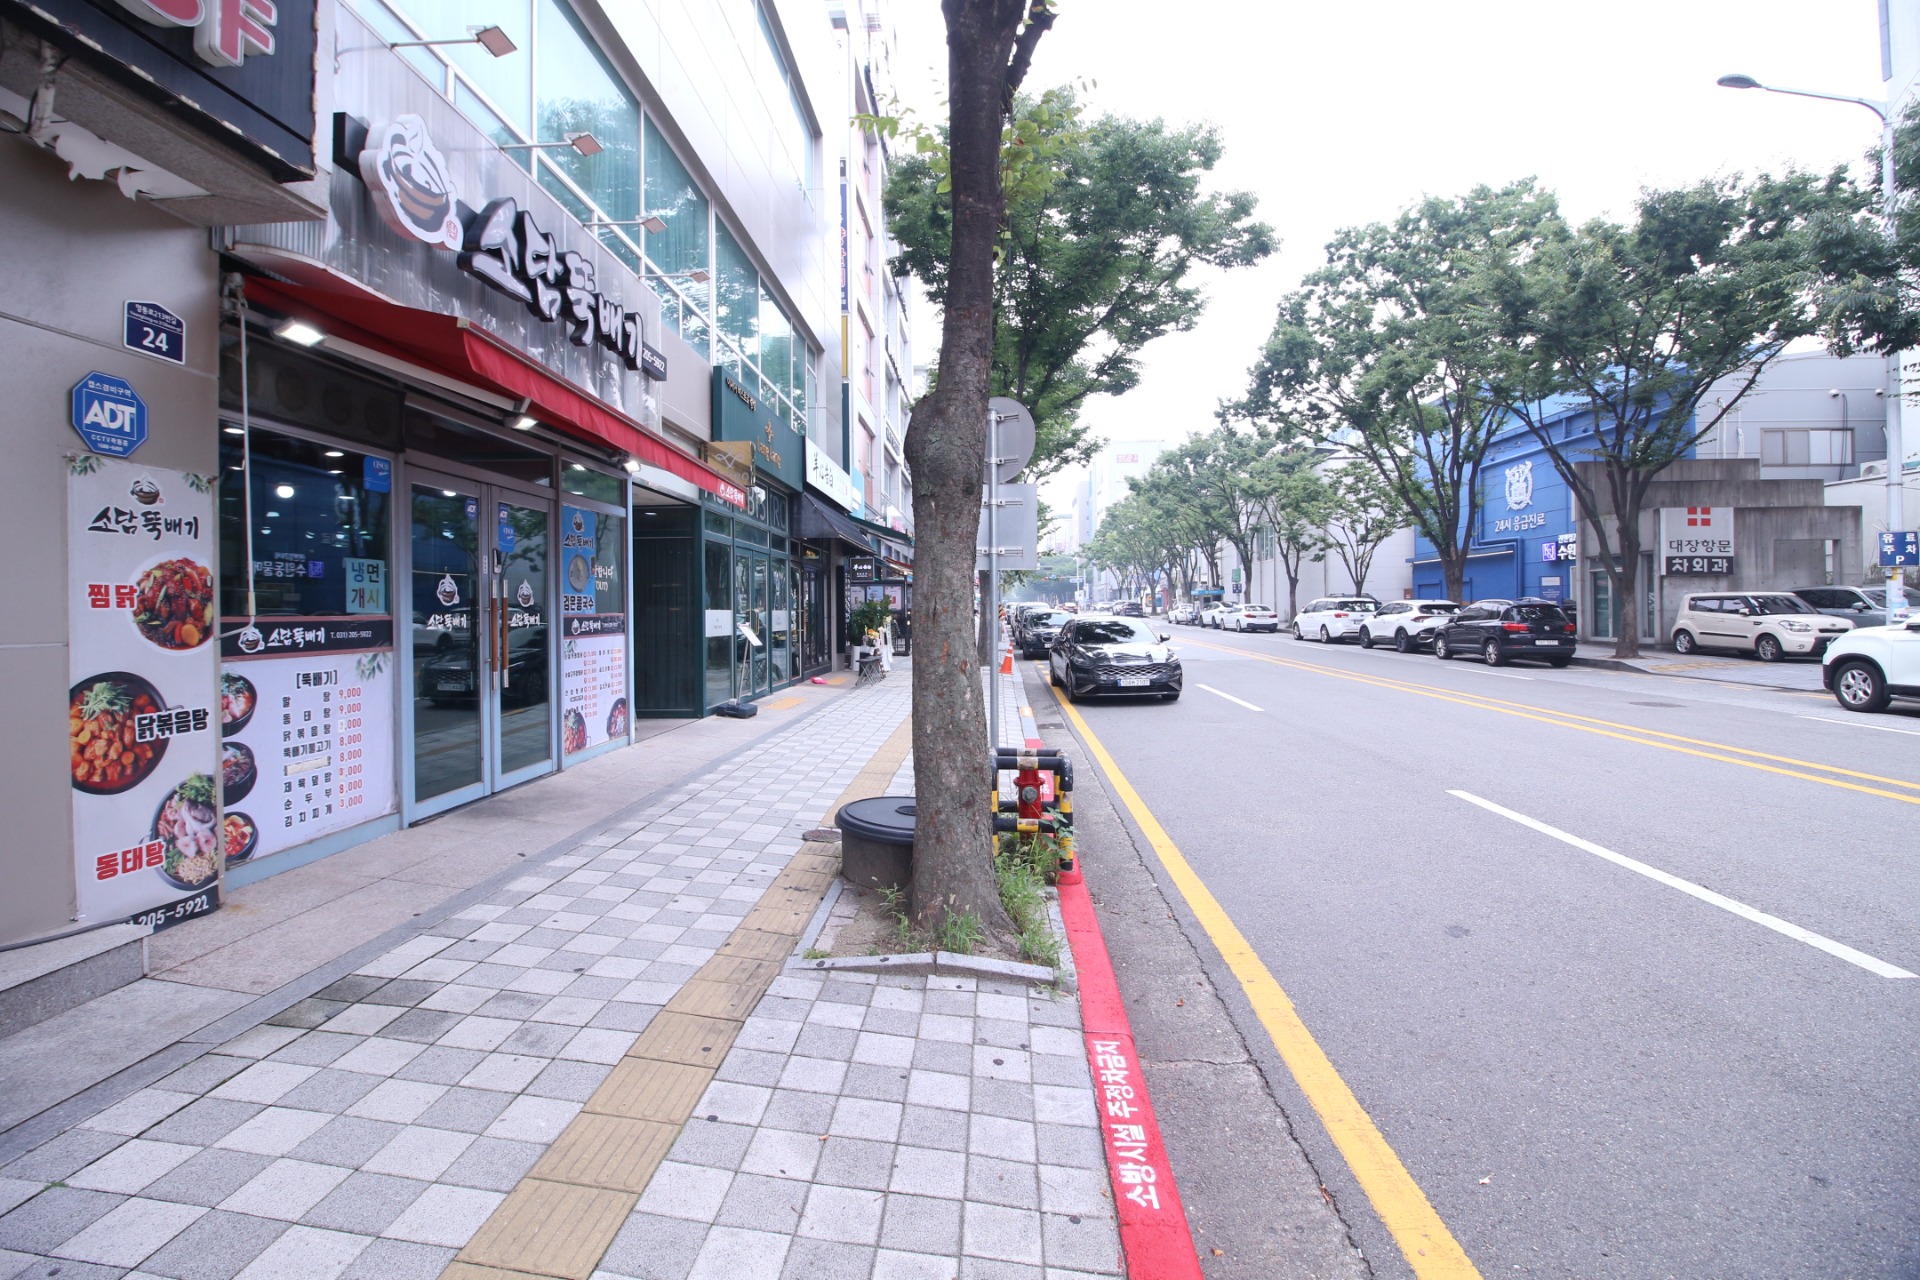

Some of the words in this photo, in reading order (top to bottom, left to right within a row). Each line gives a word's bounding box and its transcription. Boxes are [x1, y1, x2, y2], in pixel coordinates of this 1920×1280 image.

[465, 197, 643, 371] 소담뚝배기
[142, 327, 168, 351] 24
[83, 400, 136, 433] ADT
[88, 506, 199, 541] 소담뚝배기
[1494, 517, 1512, 533] 24시
[1513, 512, 1546, 532] 응급진료
[1669, 539, 1732, 553] 대장항문
[1883, 533, 1917, 543] 유료
[1883, 544, 1917, 555] 주차
[1895, 555, 1905, 565] P
[351, 562, 380, 583] 냉면
[1671, 558, 1729, 573] 차외과
[88, 583, 138, 609] 찜닭
[351, 587, 380, 609] 개시
[563, 595, 594, 611] 검은콩국수
[427, 614, 467, 631] 소담뚝배기
[509, 613, 541, 628] 소담뚝배기
[267, 627, 325, 648] 소담뚝배기
[339, 687, 361, 699] 9,000
[339, 702, 361, 714] 9,000
[137, 709, 209, 741] 닭볶음탕
[340, 733, 362, 746] 8,000
[340, 748, 362, 762] 8,000
[96, 841, 165, 880] 동태탕
[1093, 1041, 1139, 1118] 주정차금지
[1110, 1123, 1160, 1210] 소방시설
